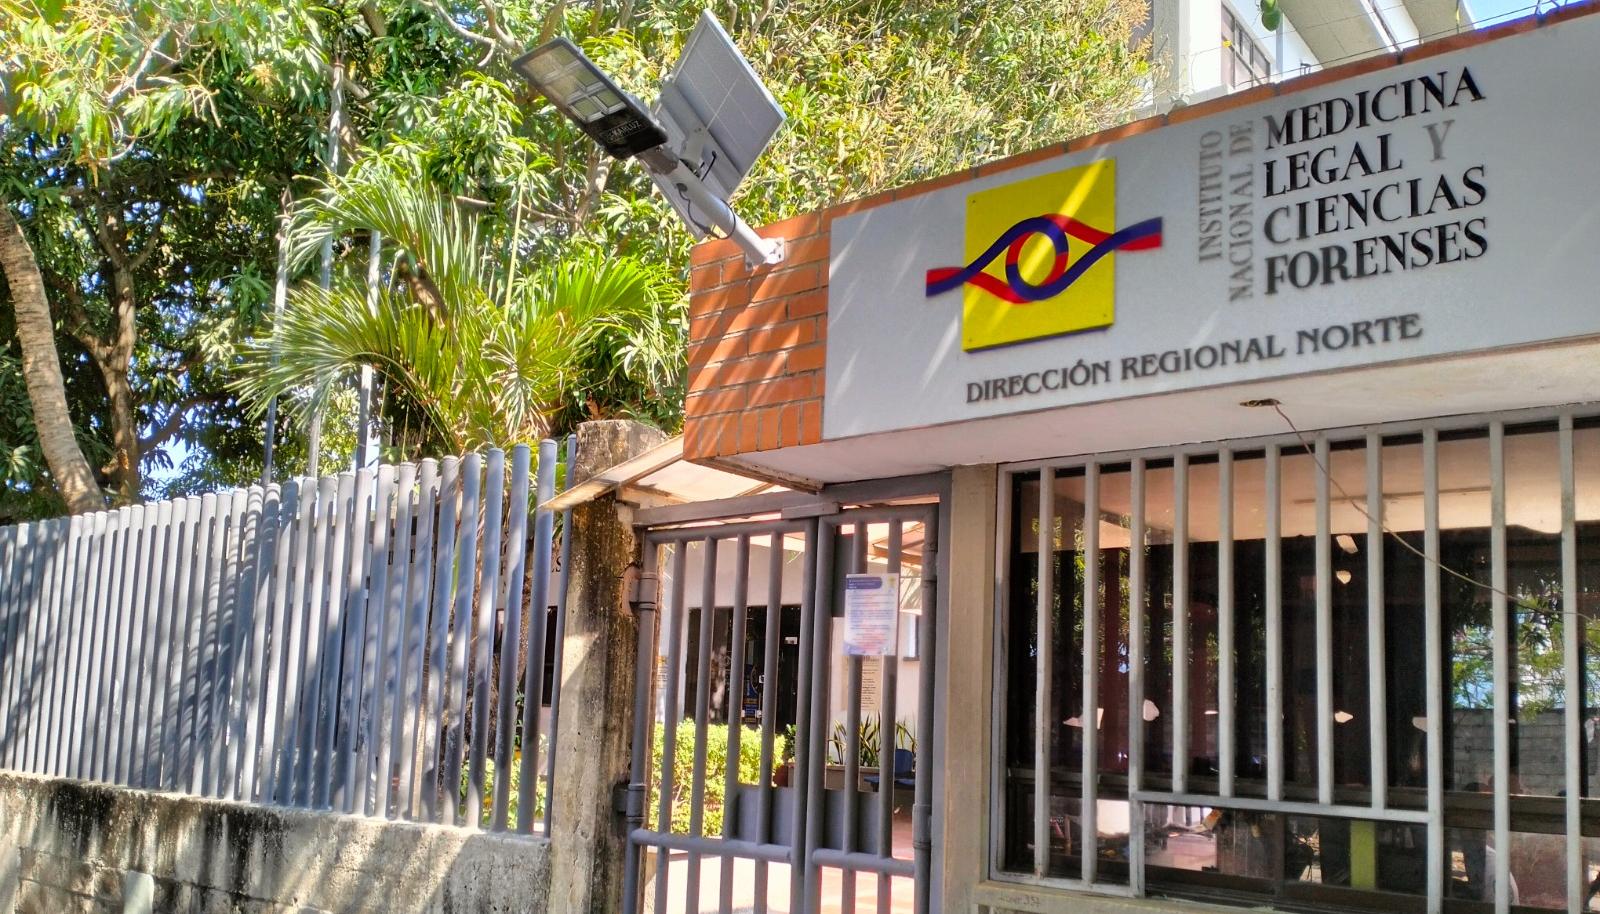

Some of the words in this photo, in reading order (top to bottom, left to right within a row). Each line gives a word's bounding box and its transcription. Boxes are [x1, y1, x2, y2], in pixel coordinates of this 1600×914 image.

[1229, 120, 1254, 157] DE
[1263, 66, 1486, 150] MEDICINA
[1199, 130, 1223, 263] INSTITUTO
[1263, 133, 1402, 198] LEGAL
[1422, 119, 1455, 162] Y
[1229, 164, 1253, 302] NACIONAL
[1263, 165, 1487, 245] CIENCIAS
[1264, 216, 1488, 295] FORENSES
[966, 358, 1110, 403] DIRECCIÓN
[1121, 334, 1286, 381] REGIONAL
[1295, 312, 1424, 355] NORTE
